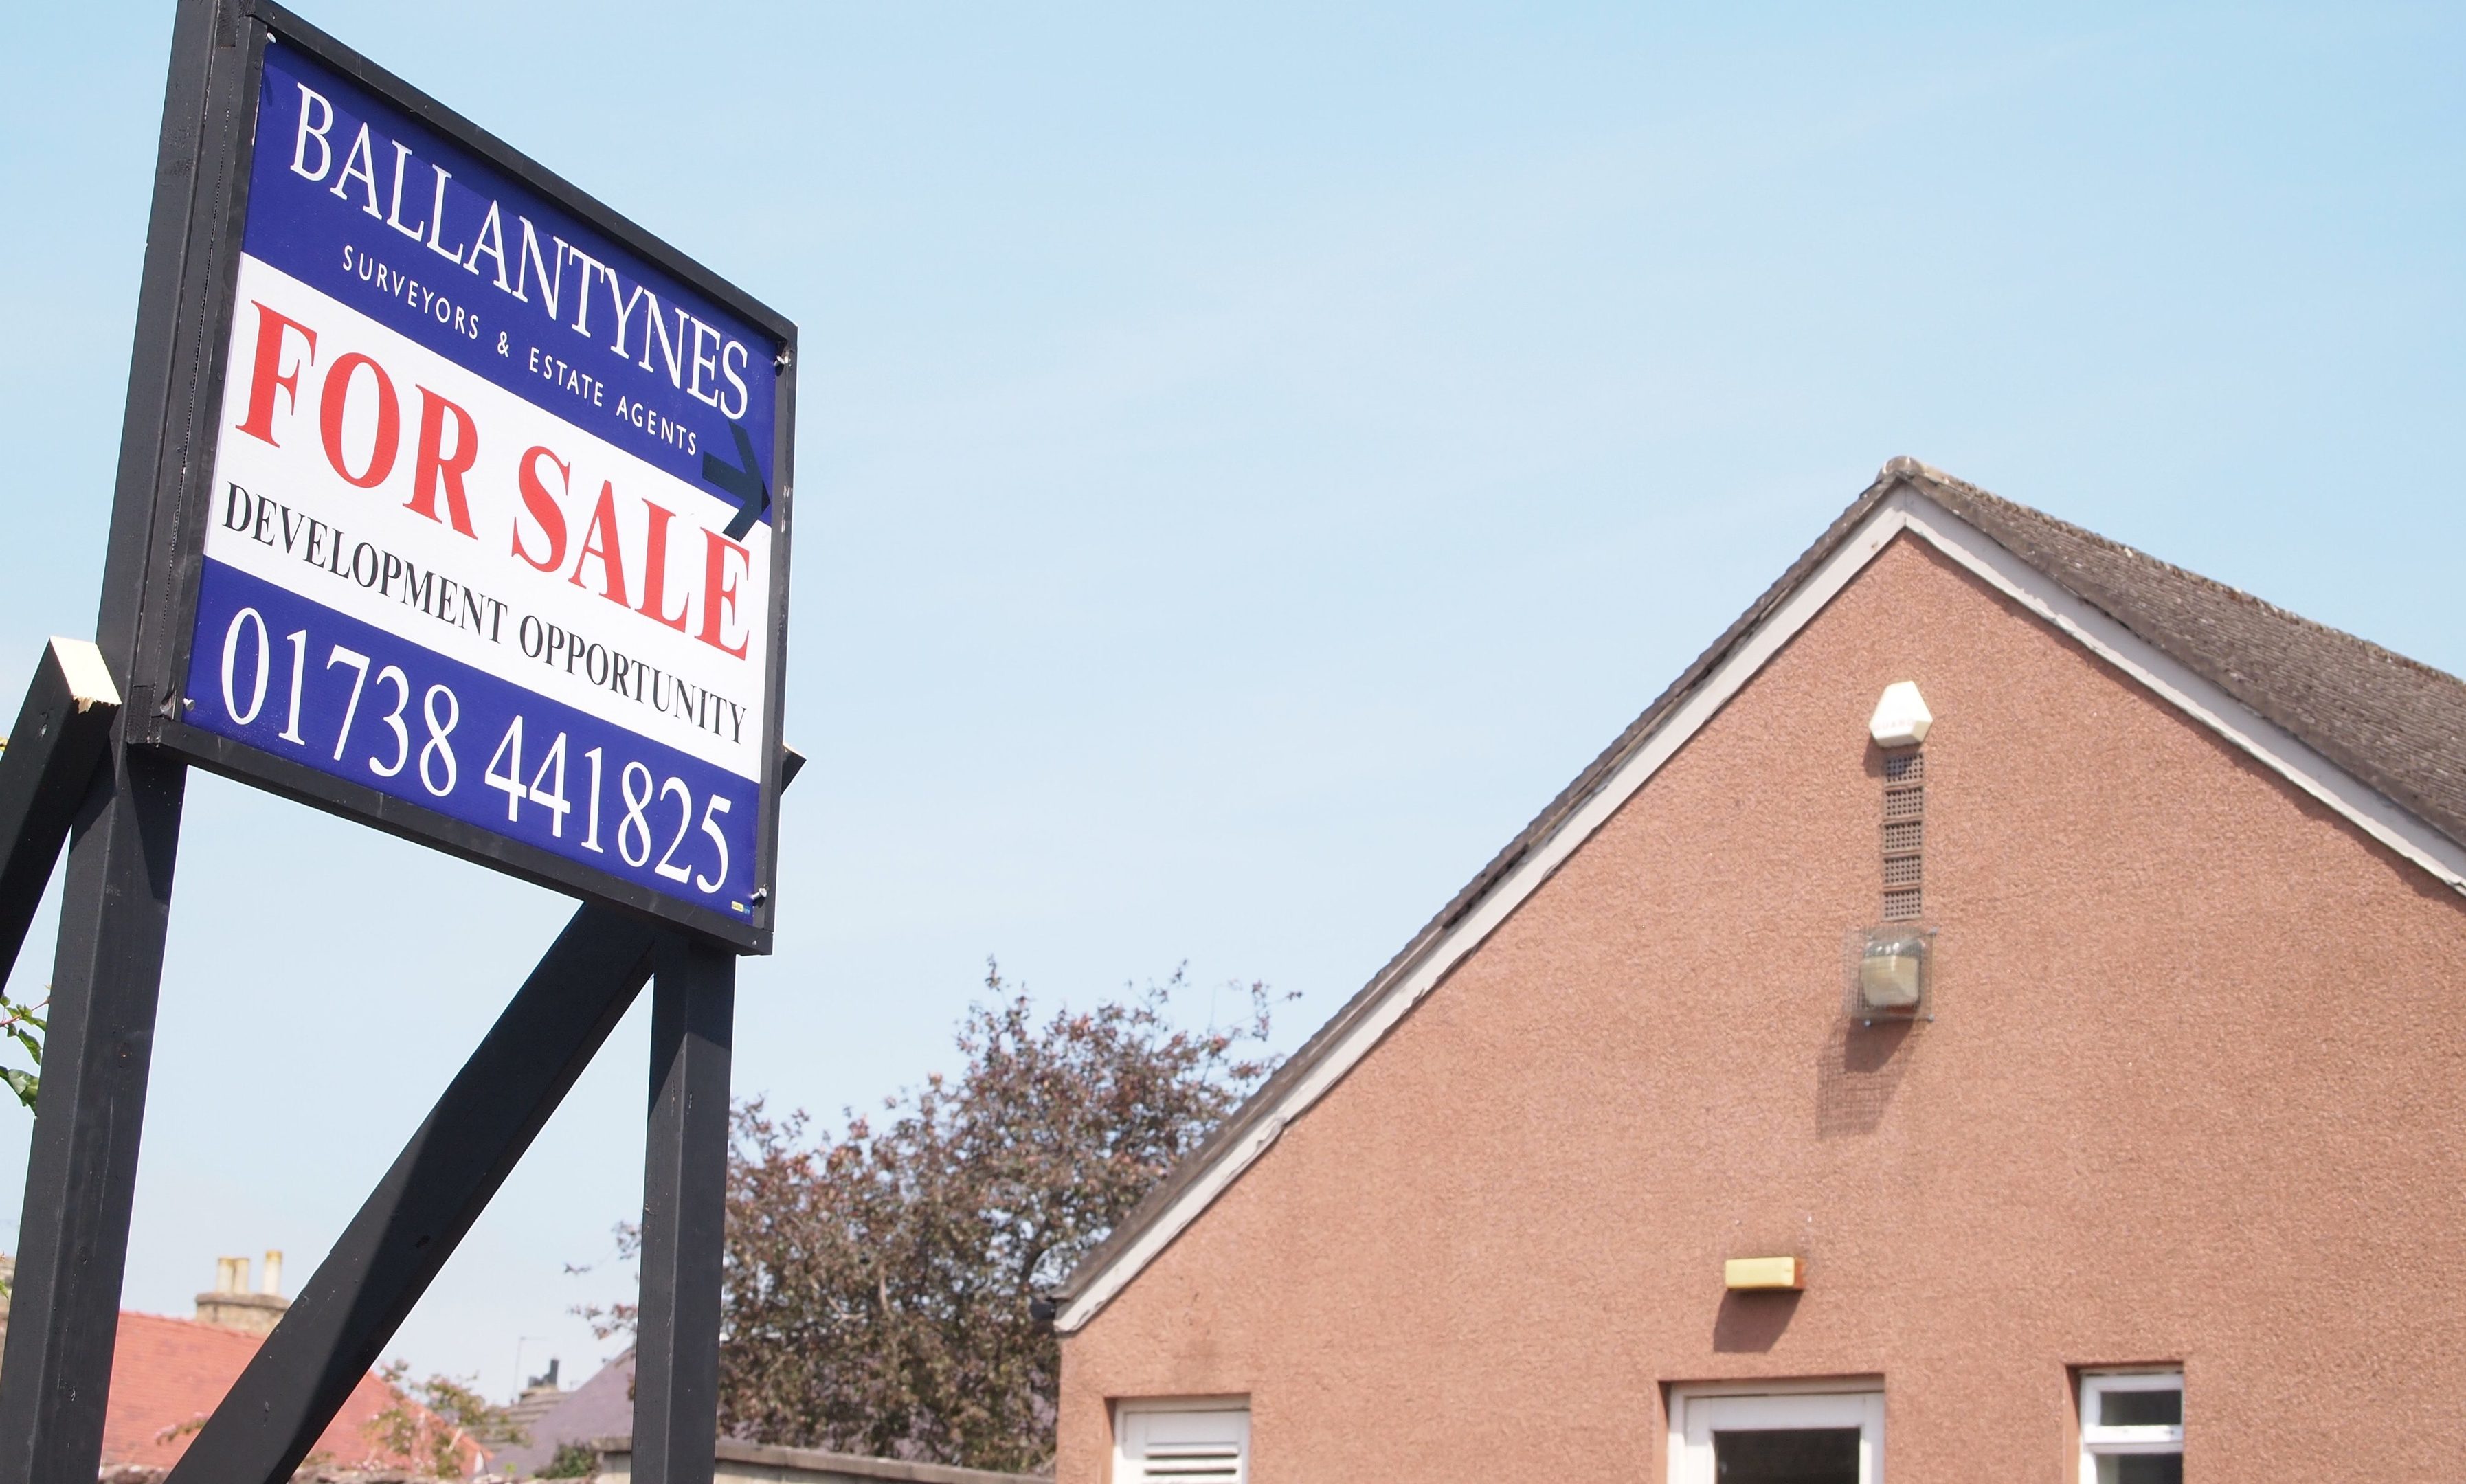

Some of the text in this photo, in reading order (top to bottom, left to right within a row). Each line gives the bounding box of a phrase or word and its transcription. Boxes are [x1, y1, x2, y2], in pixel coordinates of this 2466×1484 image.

[291, 82, 748, 420] BALLANTYNES
[342, 245, 697, 456] SURVEYORS & ESTATE AGENTS
[223, 482, 746, 744] DEVELOPMENT OPPORTUNITY
[236, 300, 750, 660] FOR SALE
[221, 607, 732, 894] 01738 441825
